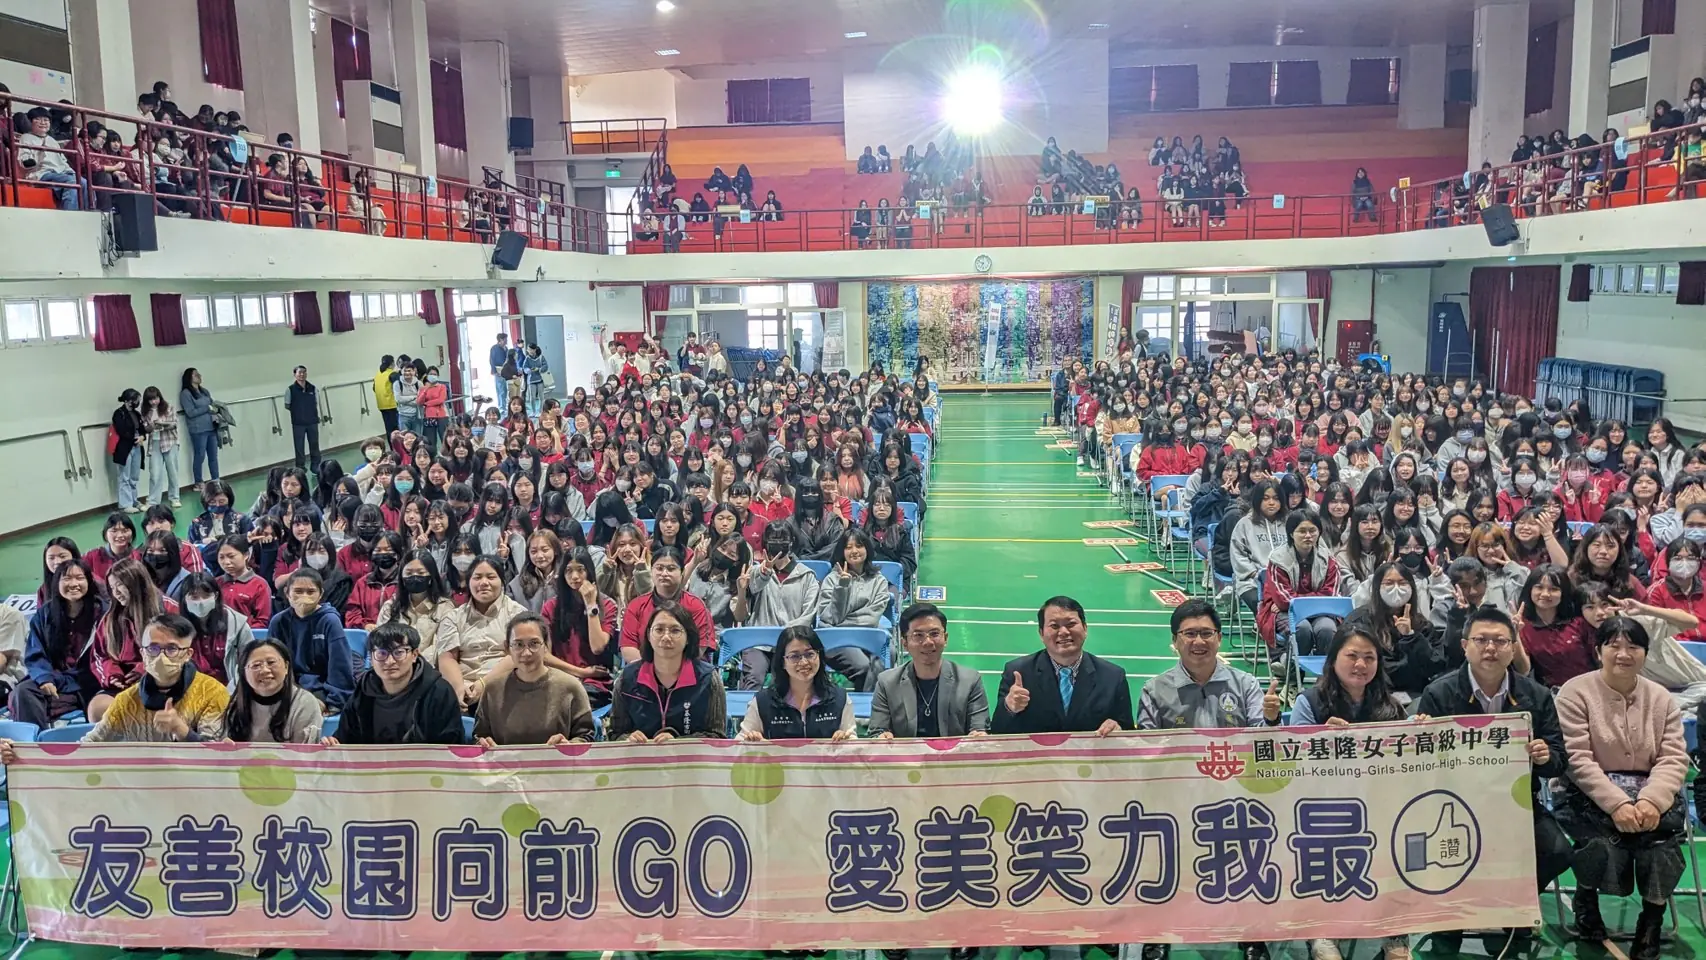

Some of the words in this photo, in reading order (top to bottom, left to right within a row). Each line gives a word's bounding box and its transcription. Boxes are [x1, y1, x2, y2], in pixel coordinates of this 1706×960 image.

[1253, 727, 1510, 763] 國立基隆女子高級中學
[1256, 766, 1305, 779] National
[1311, 766, 1361, 779] Keelung
[1368, 764, 1395, 775] Girls
[1401, 761, 1436, 773] Senior
[1439, 756, 1462, 770] High
[1468, 755, 1509, 766] School
[69, 814, 753, 922] 友善校園向前GO
[826, 796, 1378, 912] 愛美笑力我最
[1439, 838, 1460, 860] 讚
